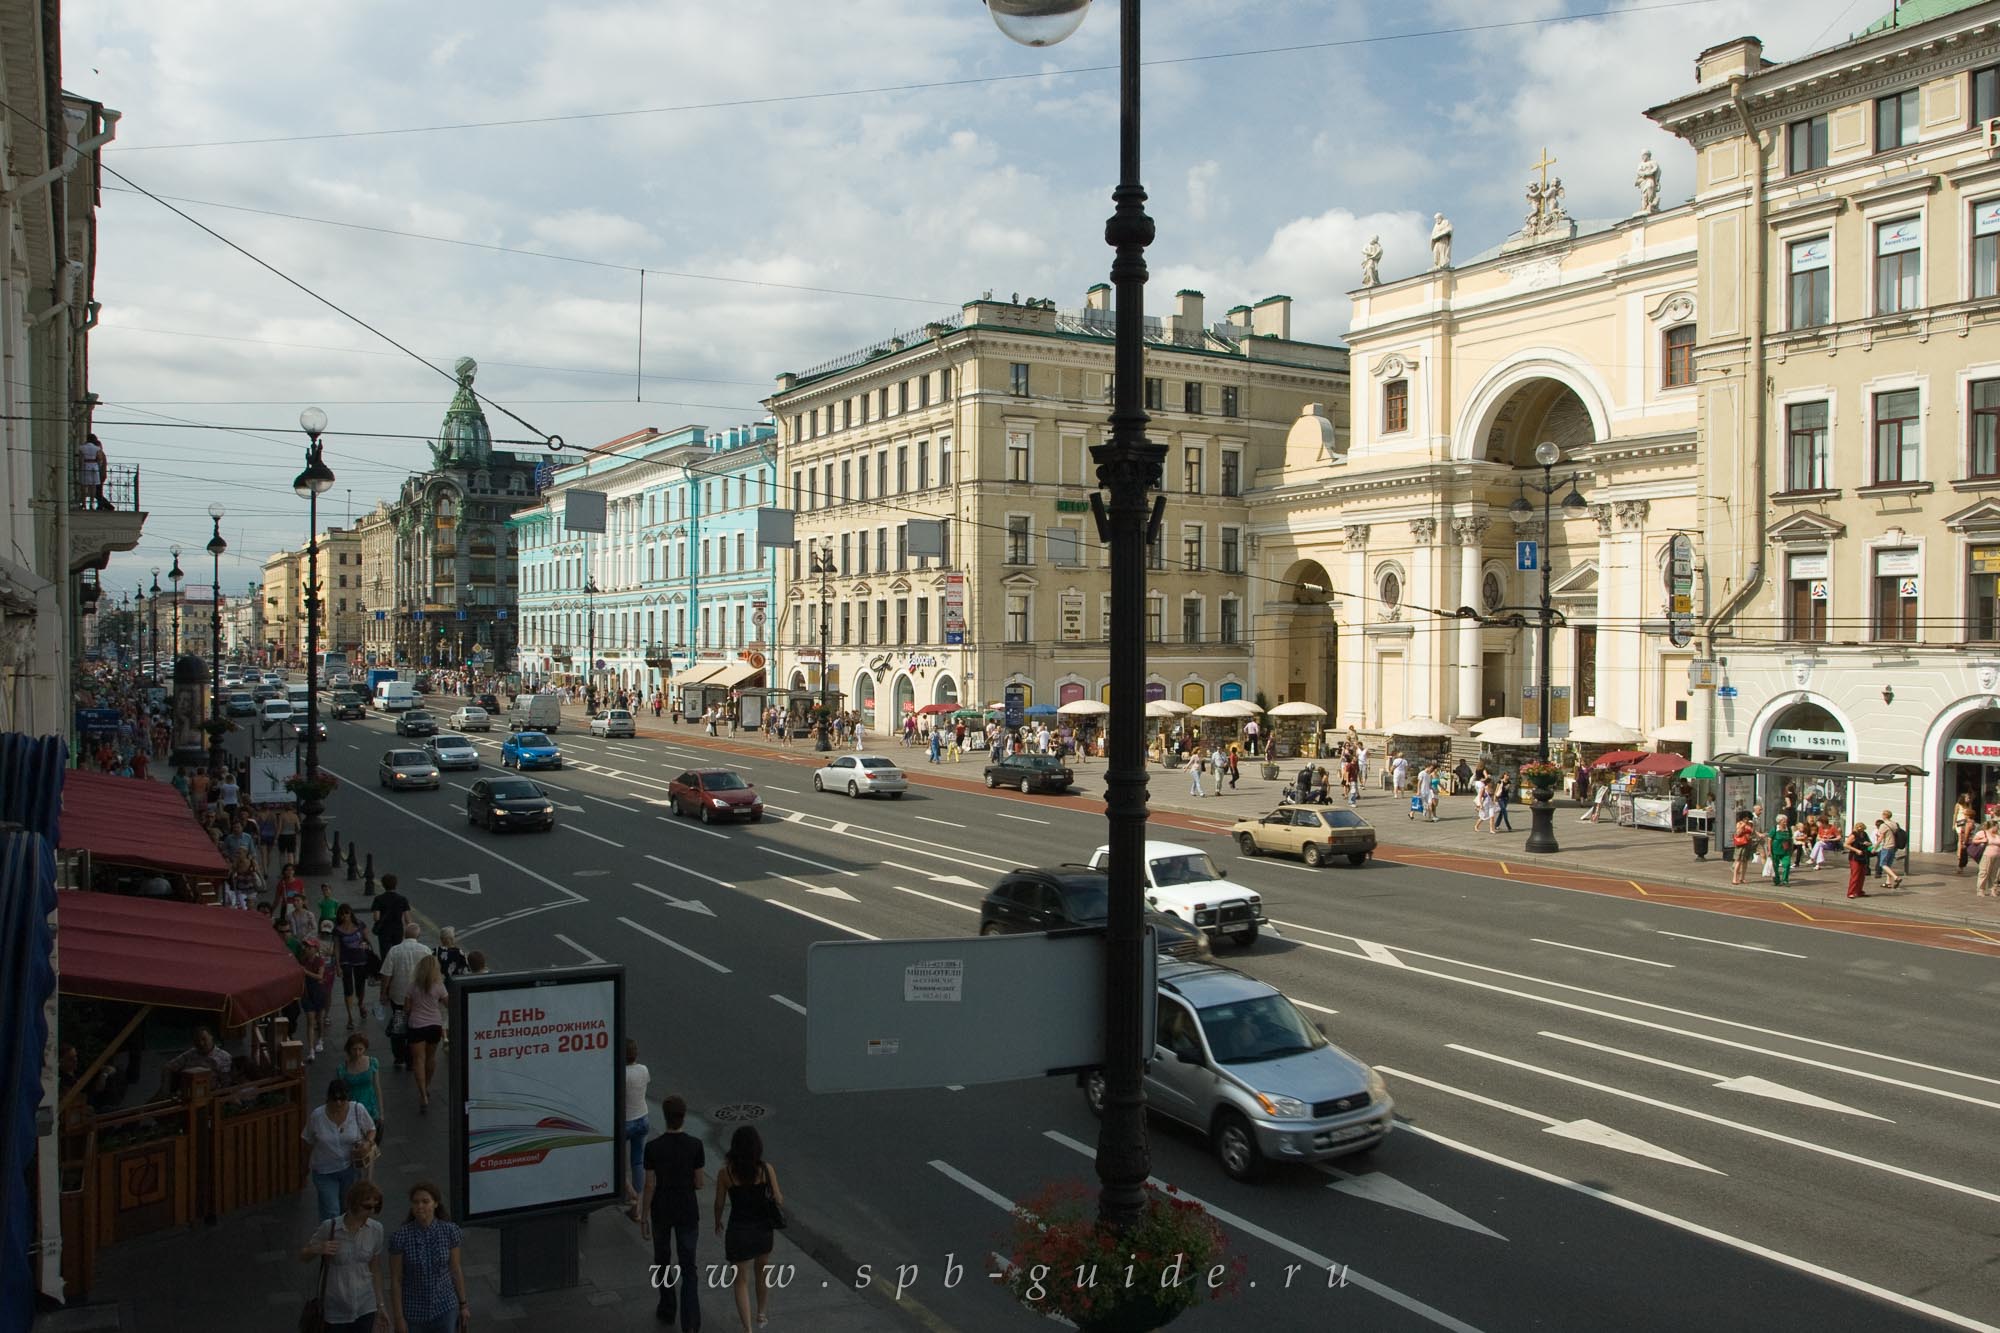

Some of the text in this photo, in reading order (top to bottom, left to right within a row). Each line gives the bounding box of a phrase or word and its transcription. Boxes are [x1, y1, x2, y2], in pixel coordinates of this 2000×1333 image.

[497, 1007, 545, 1026] ДЕНЬ
[474, 1019, 606, 1041] ЖЕЛЕЗНОДОРОЖНИКА
[474, 1031, 608, 1060] 1 августа 2010
[488, 1153, 540, 1168] Праздником!
